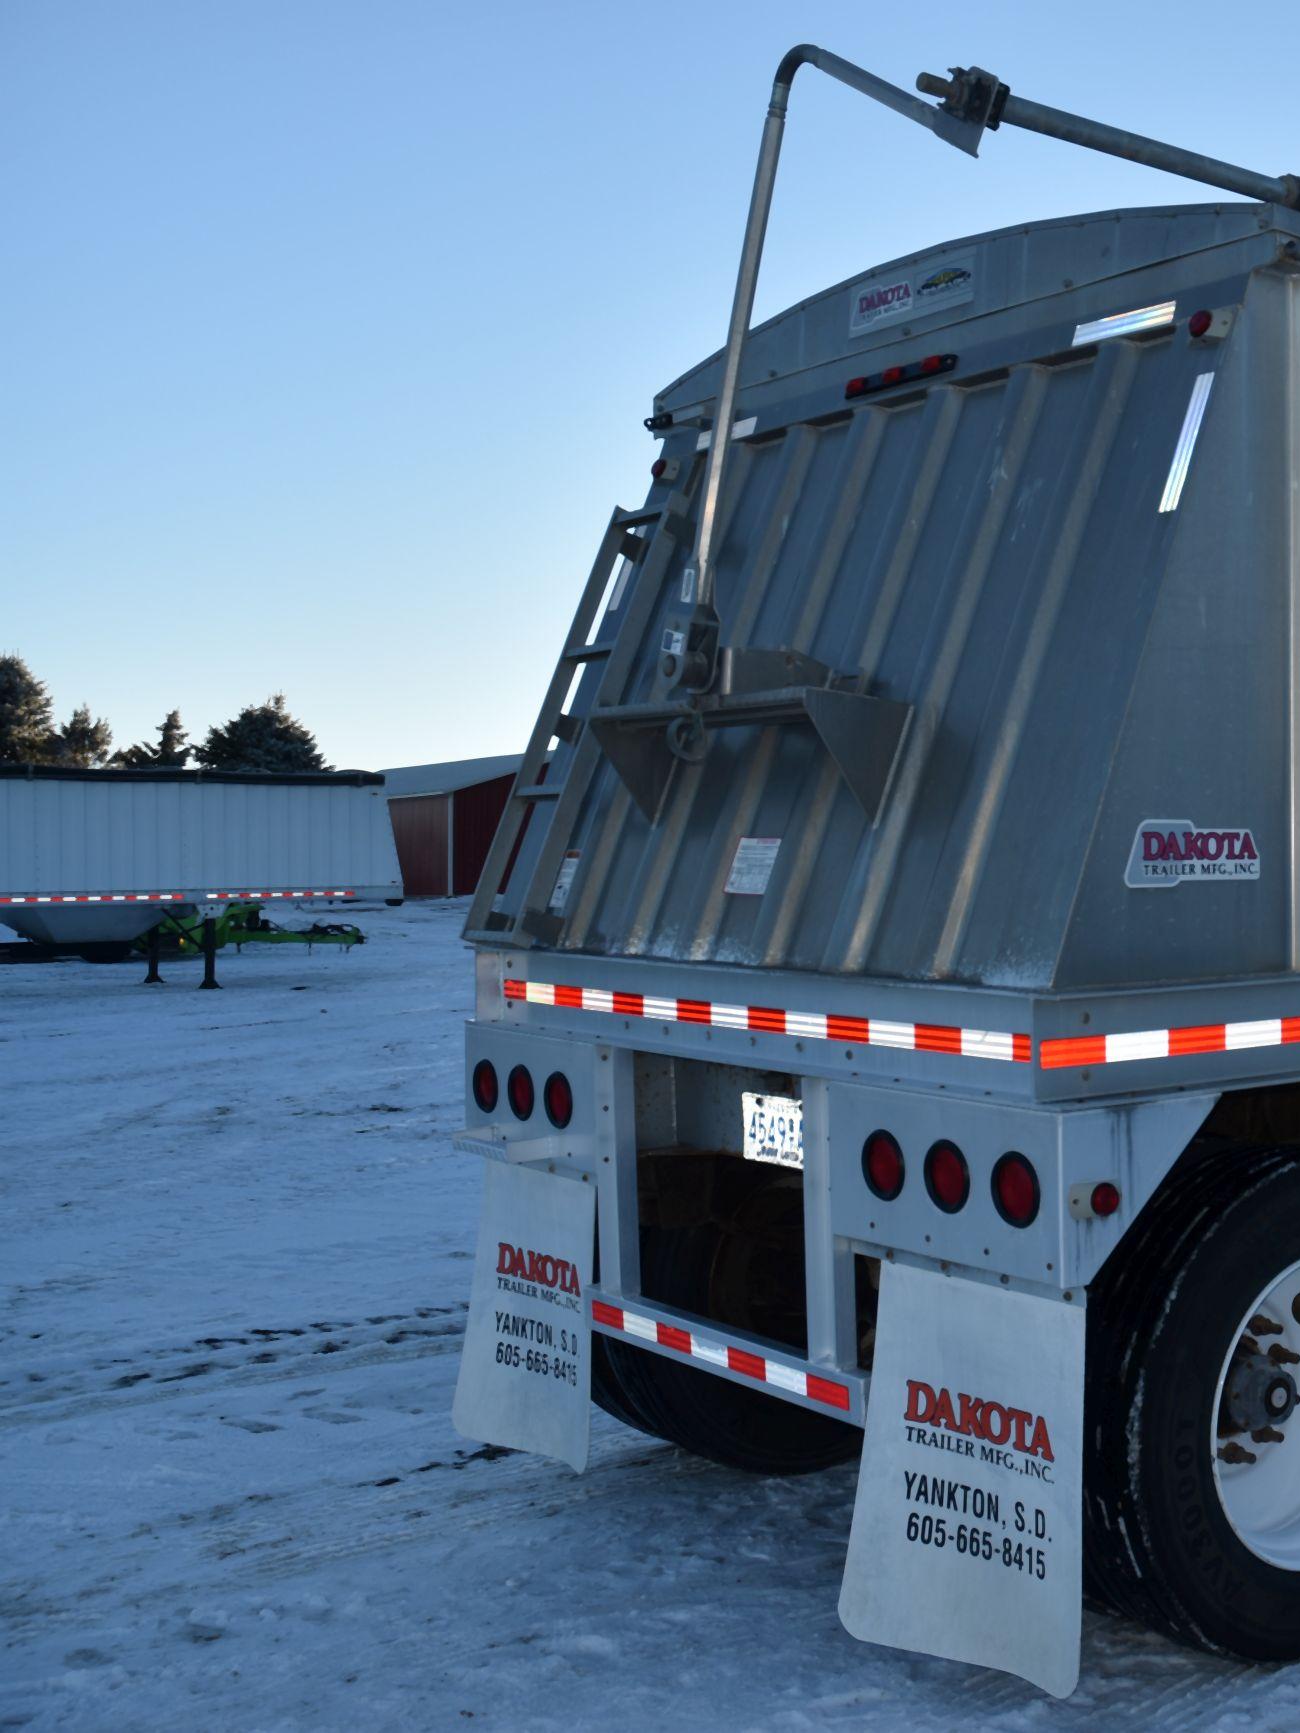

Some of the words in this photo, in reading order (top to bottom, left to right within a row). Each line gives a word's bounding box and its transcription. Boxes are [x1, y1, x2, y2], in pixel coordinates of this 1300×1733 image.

[859, 283, 911, 314] DAKOTA
[1142, 832, 1258, 861] DAKOTA
[1144, 863, 1196, 876] TRAILER
[496, 1242, 581, 1297] DAKOTA
[497, 1277, 538, 1299] TRAILER
[495, 1341, 577, 1387] 605-665-8415
[904, 1379, 1055, 1463] DAKOTA
[905, 1426, 976, 1458] TRAILER
[904, 1470, 1007, 1529] YANKTON,
[906, 1512, 1046, 1580] 605-665-8415
